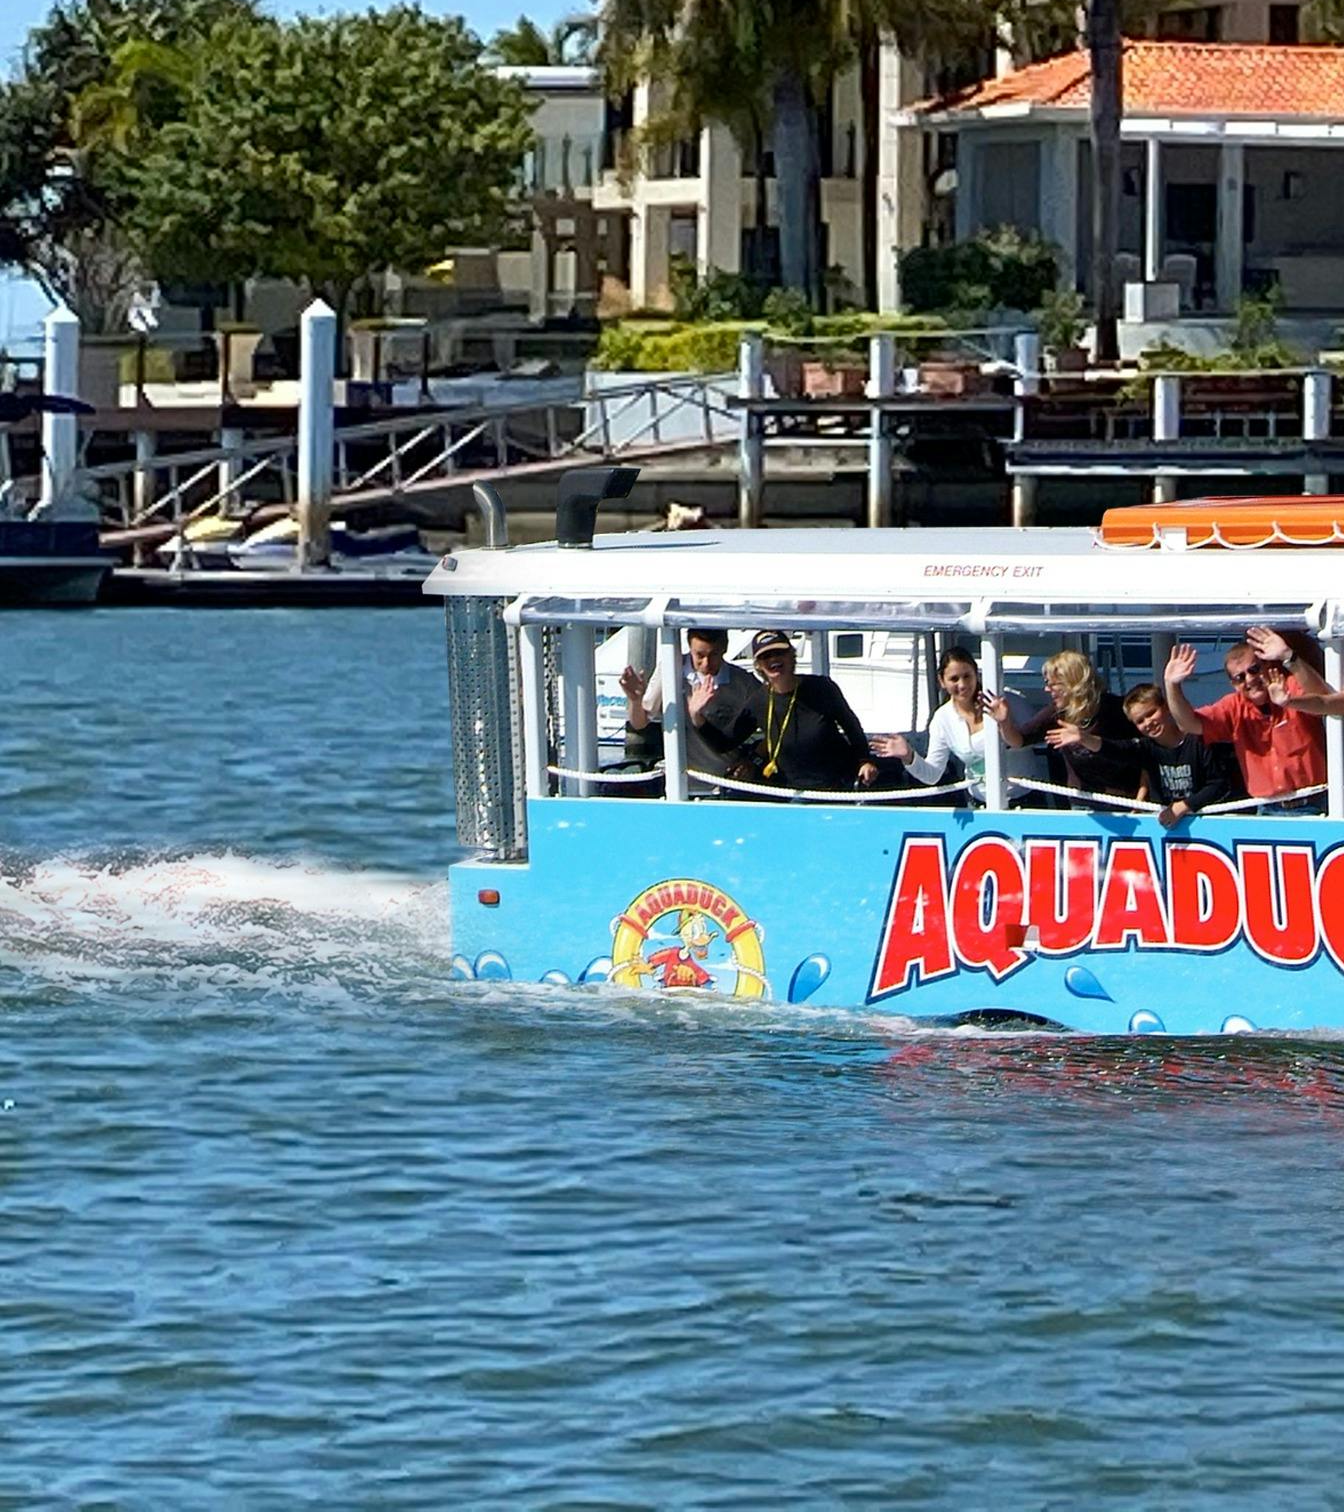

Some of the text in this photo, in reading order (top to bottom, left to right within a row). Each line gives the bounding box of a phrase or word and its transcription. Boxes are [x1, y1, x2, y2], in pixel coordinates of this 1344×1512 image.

[923, 564, 1044, 578] EMERGENCY EXIT
[634, 883, 741, 929] AQUADUCK
